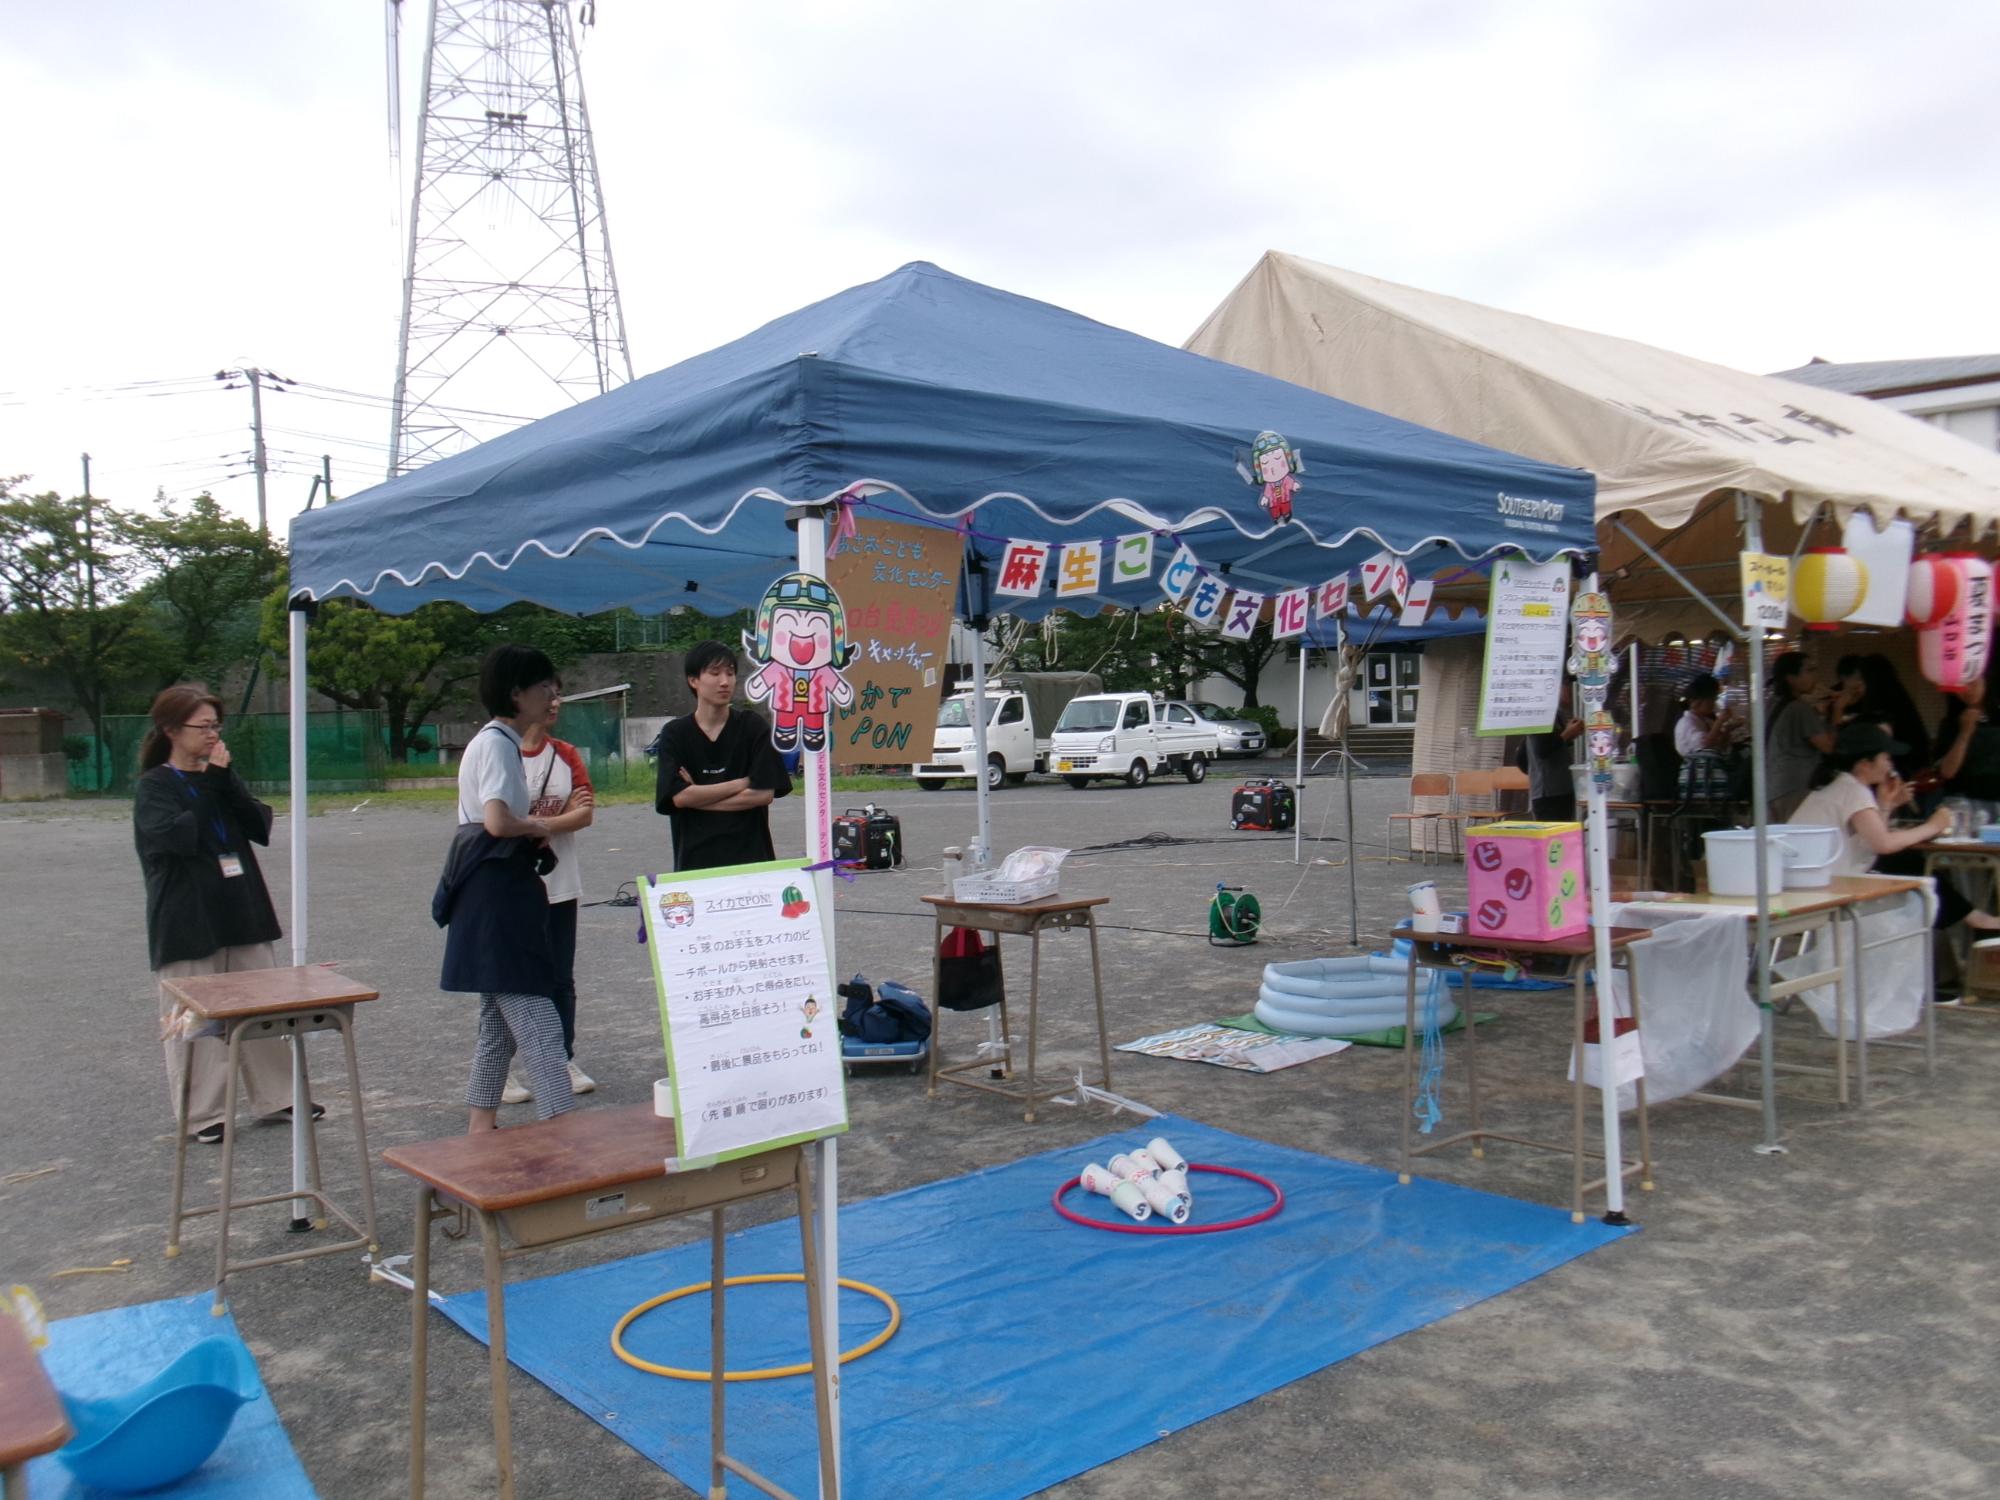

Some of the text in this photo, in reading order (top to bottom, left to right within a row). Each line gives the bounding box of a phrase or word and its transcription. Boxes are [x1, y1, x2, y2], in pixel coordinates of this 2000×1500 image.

[854, 639, 933, 671] キャッチャー
[851, 716, 912, 751] PON
